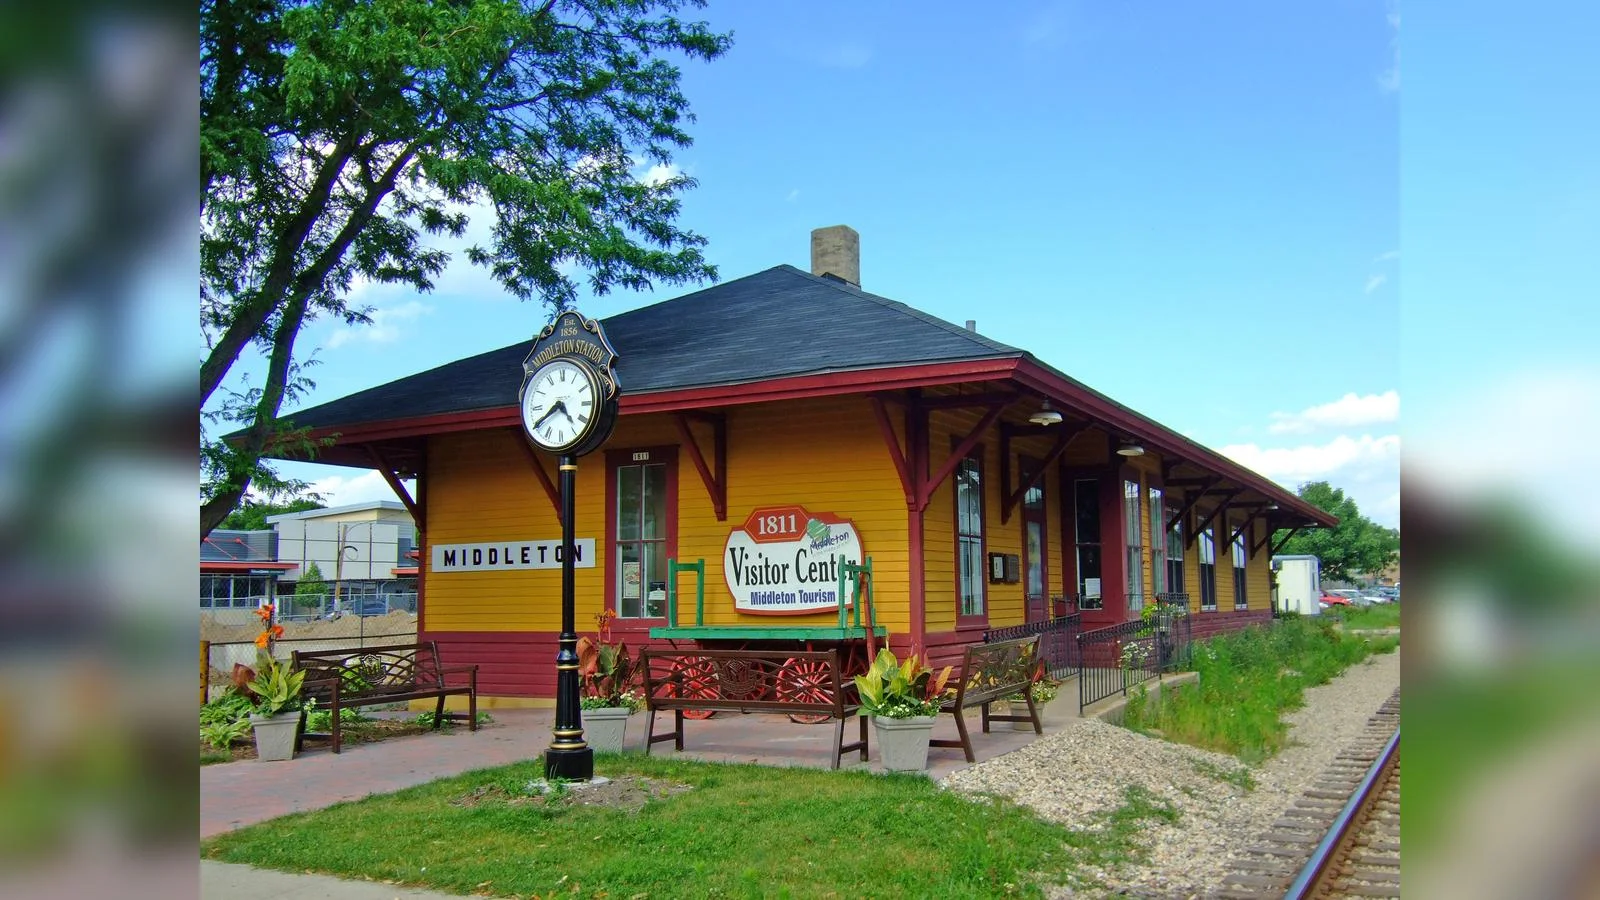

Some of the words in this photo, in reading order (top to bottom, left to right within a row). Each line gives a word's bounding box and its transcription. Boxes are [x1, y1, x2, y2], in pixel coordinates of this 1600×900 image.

[560, 327, 578, 337] 1856
[532, 340, 573, 367] MIDDLETON
[574, 340, 605, 363] STATION
[758, 514, 797, 535] 1811
[444, 545, 582, 566] MIDDLETON
[729, 546, 789, 586] Visitor
[795, 548, 857, 583] Centr
[750, 590, 796, 605] Middleton
[798, 589, 836, 604] Tourism
